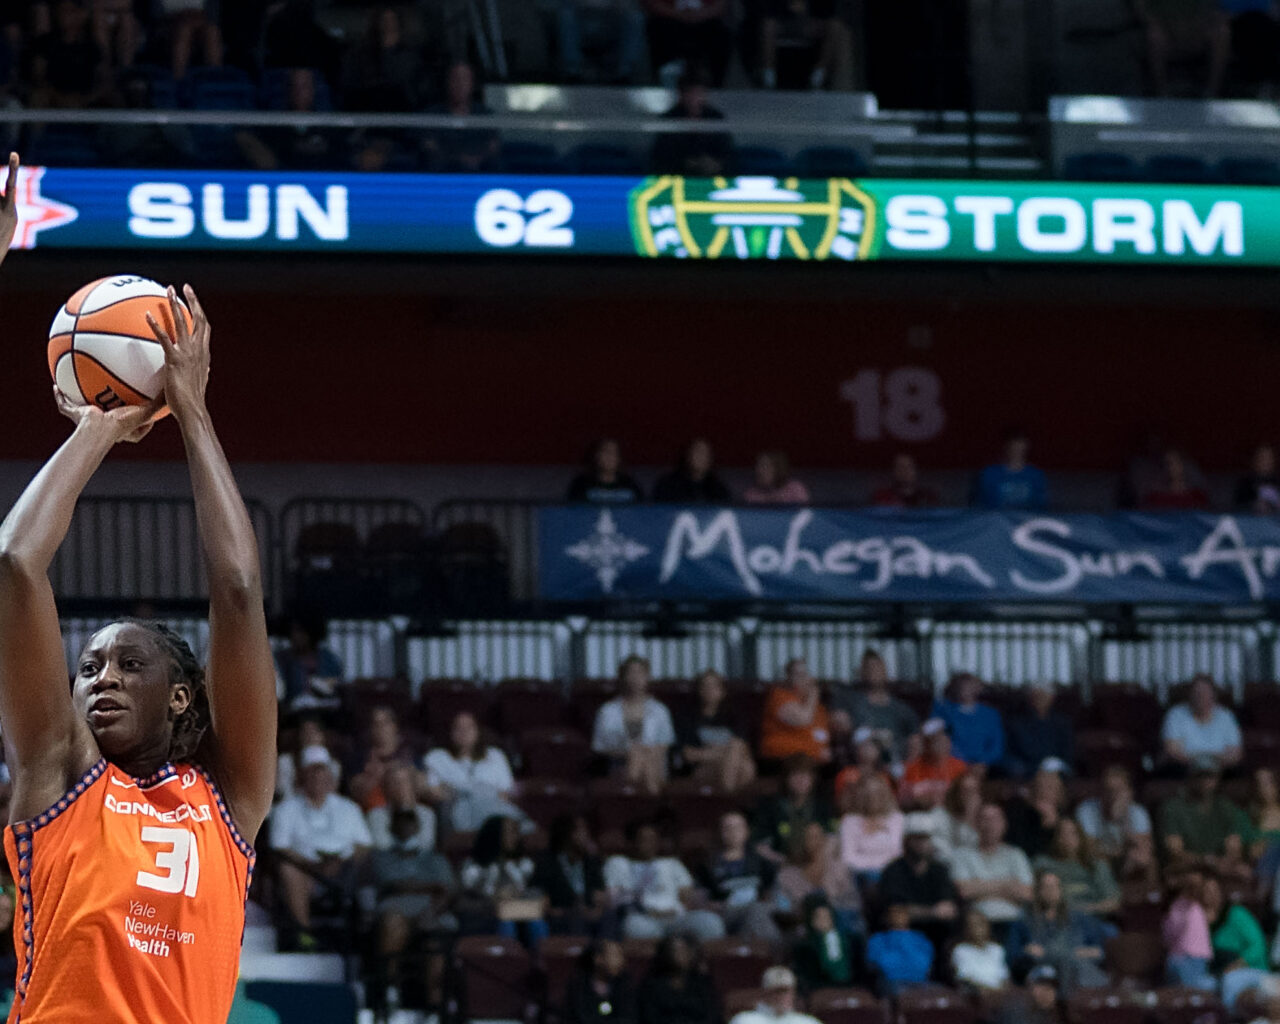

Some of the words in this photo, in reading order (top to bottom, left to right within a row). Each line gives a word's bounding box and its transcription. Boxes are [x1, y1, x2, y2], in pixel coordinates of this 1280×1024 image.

[128, 182, 349, 241] SUN
[475, 188, 574, 247] 62
[884, 194, 1245, 257] STORM
[839, 367, 945, 441] 18
[658, 508, 995, 597] Mohegan
[1010, 518, 1166, 593] Sun
[136, 825, 200, 898] 31
[124, 916, 195, 944] NewHaven
[129, 899, 156, 918] Yale
[127, 933, 170, 957] Health
